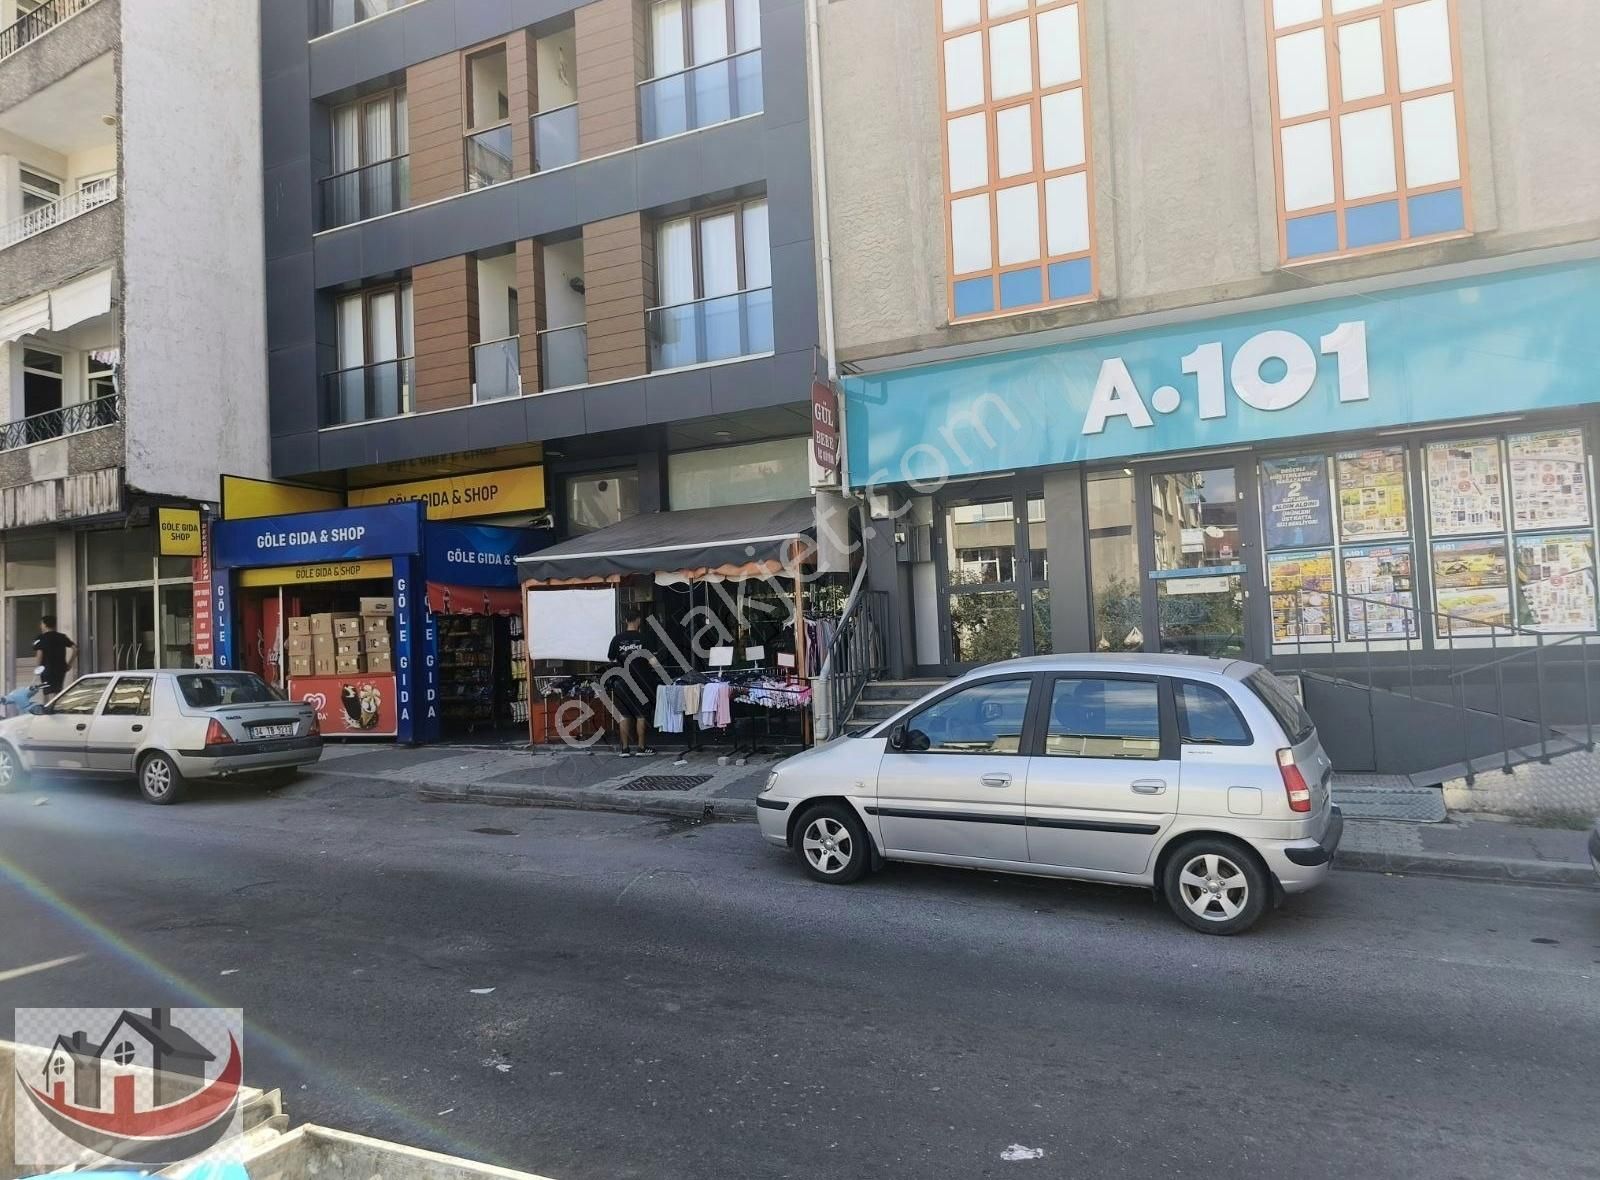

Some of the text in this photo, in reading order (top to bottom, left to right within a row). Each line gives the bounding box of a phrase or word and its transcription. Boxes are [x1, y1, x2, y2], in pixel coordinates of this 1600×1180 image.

[814, 401, 834, 428] GÜL
[451, 489, 461, 503] &
[464, 485, 498, 503] SHOP
[1288, 482, 1302, 497] 2
[171, 532, 191, 541] SHOP
[182, 524, 198, 532] GIDA
[257, 526, 365, 548] GÖLE GIDA & SHOP
[447, 549, 475, 564] GÖLE
[478, 552, 502, 565] GIDA
[504, 555, 511, 565] &
[316, 567, 332, 578] GIDA
[334, 566, 340, 577] &
[341, 565, 361, 576] SHOP
[217, 585, 226, 642] GÖLE
[398, 579, 410, 720] GÖLE GIDA
[426, 655, 436, 718] GIDA
